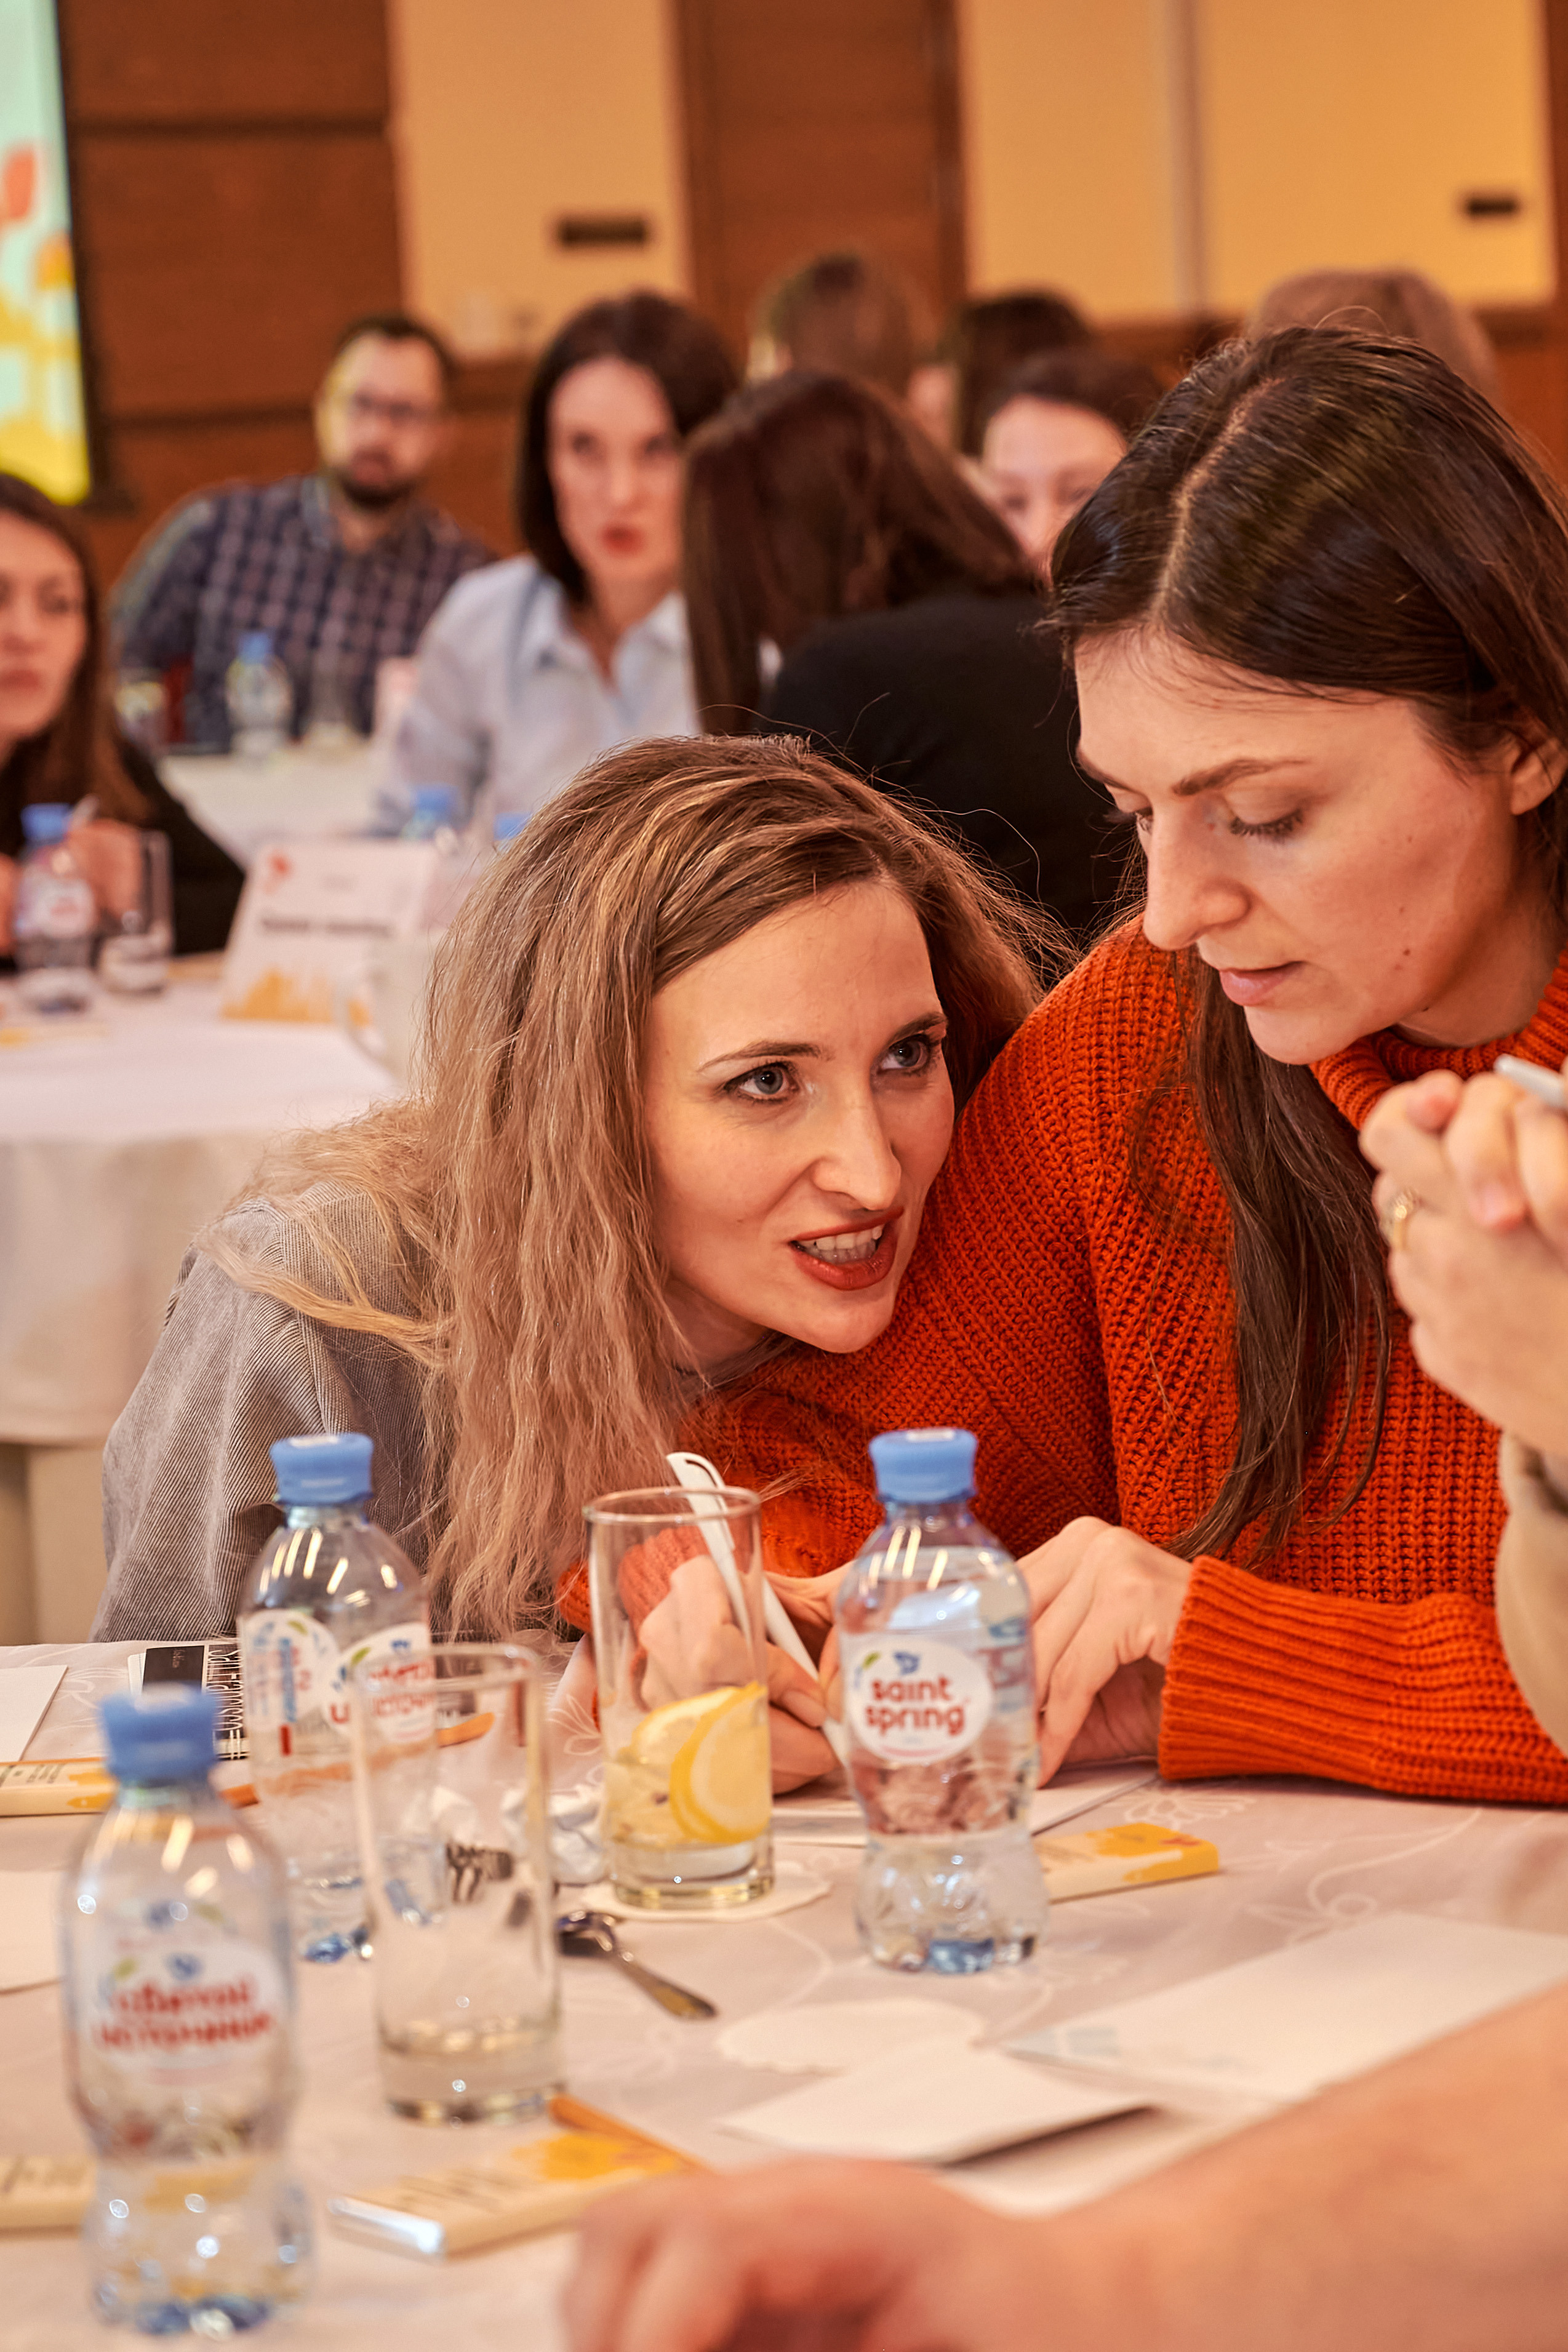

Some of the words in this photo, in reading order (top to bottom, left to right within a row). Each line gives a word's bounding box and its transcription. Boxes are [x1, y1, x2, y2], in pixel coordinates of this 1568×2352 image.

[208, 1649, 242, 1670] San
[872, 1675, 951, 1702] saint
[865, 1705, 965, 1737] spring
